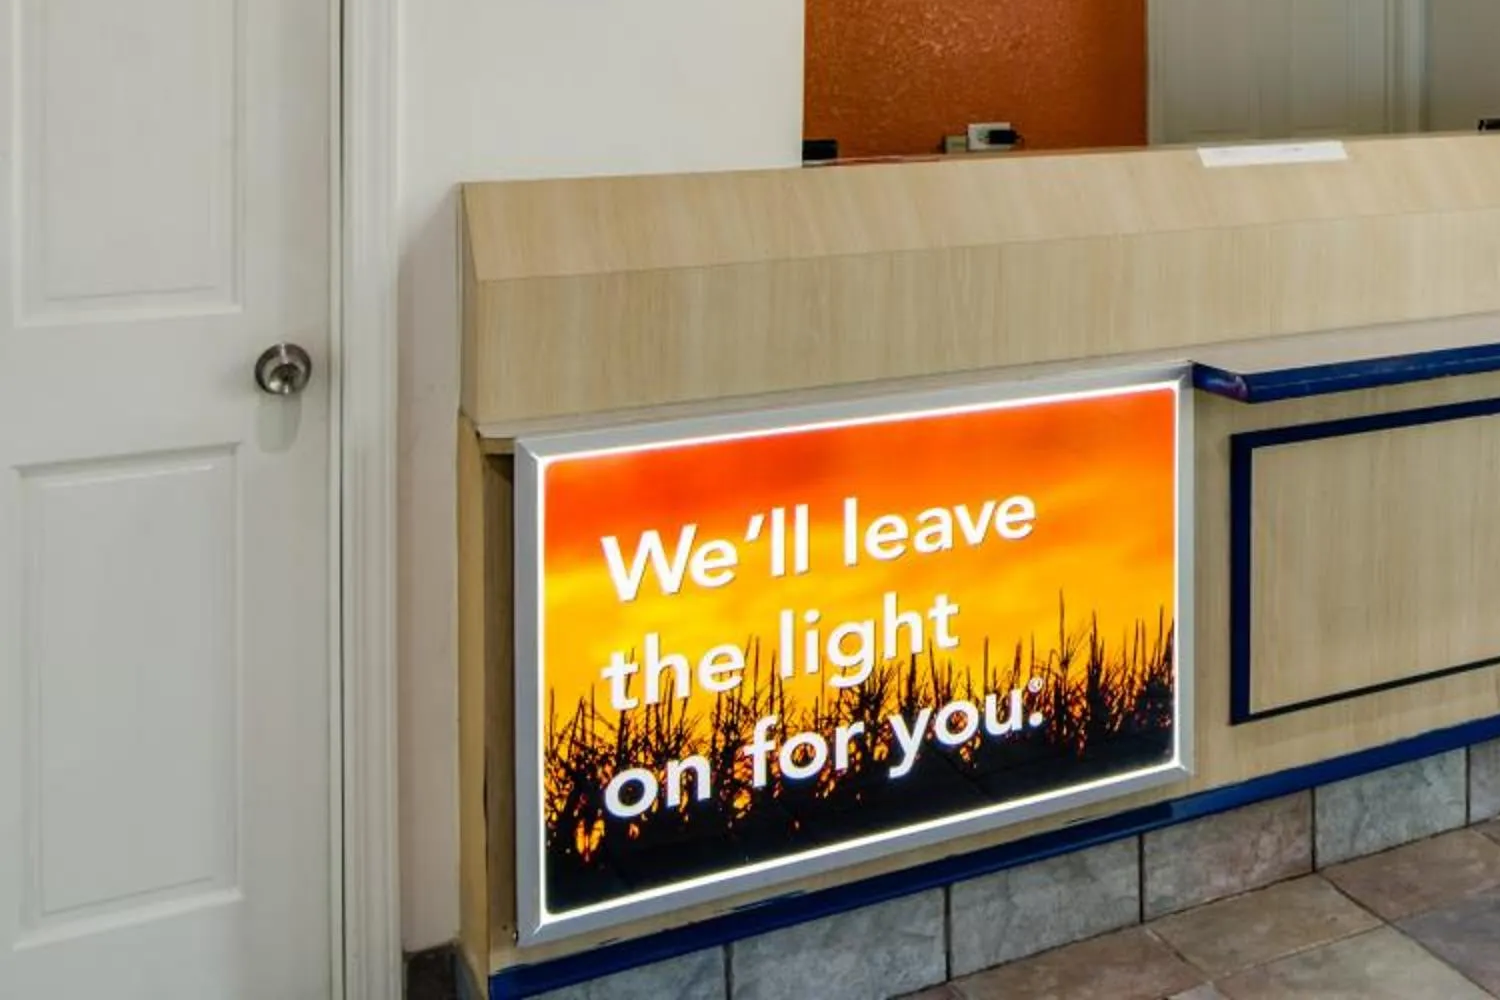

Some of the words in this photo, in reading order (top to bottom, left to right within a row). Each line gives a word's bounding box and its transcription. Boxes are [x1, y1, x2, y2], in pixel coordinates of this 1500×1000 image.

[601, 503, 810, 602] We'll
[843, 494, 1037, 567] leave
[601, 632, 745, 711] the
[779, 591, 960, 688] light
[603, 751, 712, 819] on
[743, 714, 865, 789] for
